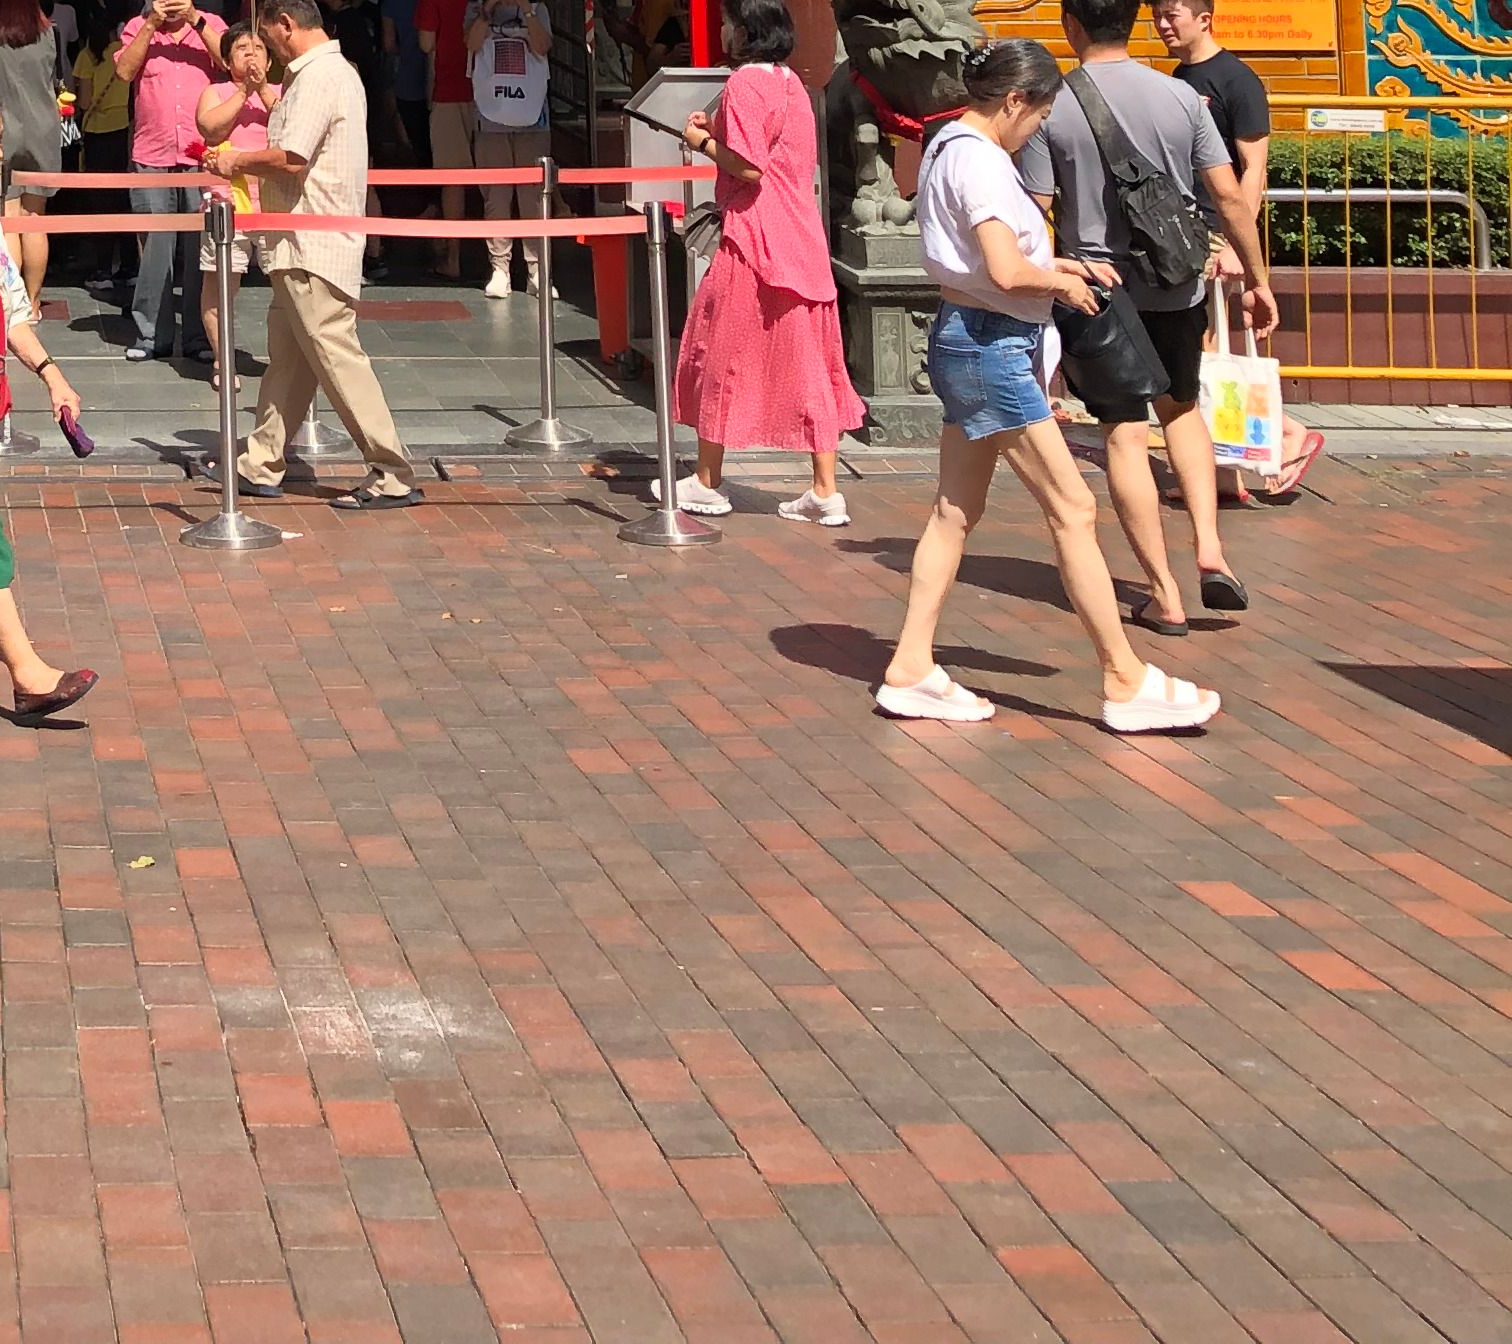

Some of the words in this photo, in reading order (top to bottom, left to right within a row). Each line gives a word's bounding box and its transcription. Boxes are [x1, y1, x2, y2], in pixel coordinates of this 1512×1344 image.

[1213, 14, 1257, 24] OPENING
[1259, 14, 1292, 24] HOURS
[1233, 30, 1245, 39] to
[1288, 29, 1313, 41] Daily
[494, 85, 525, 99] FILA
